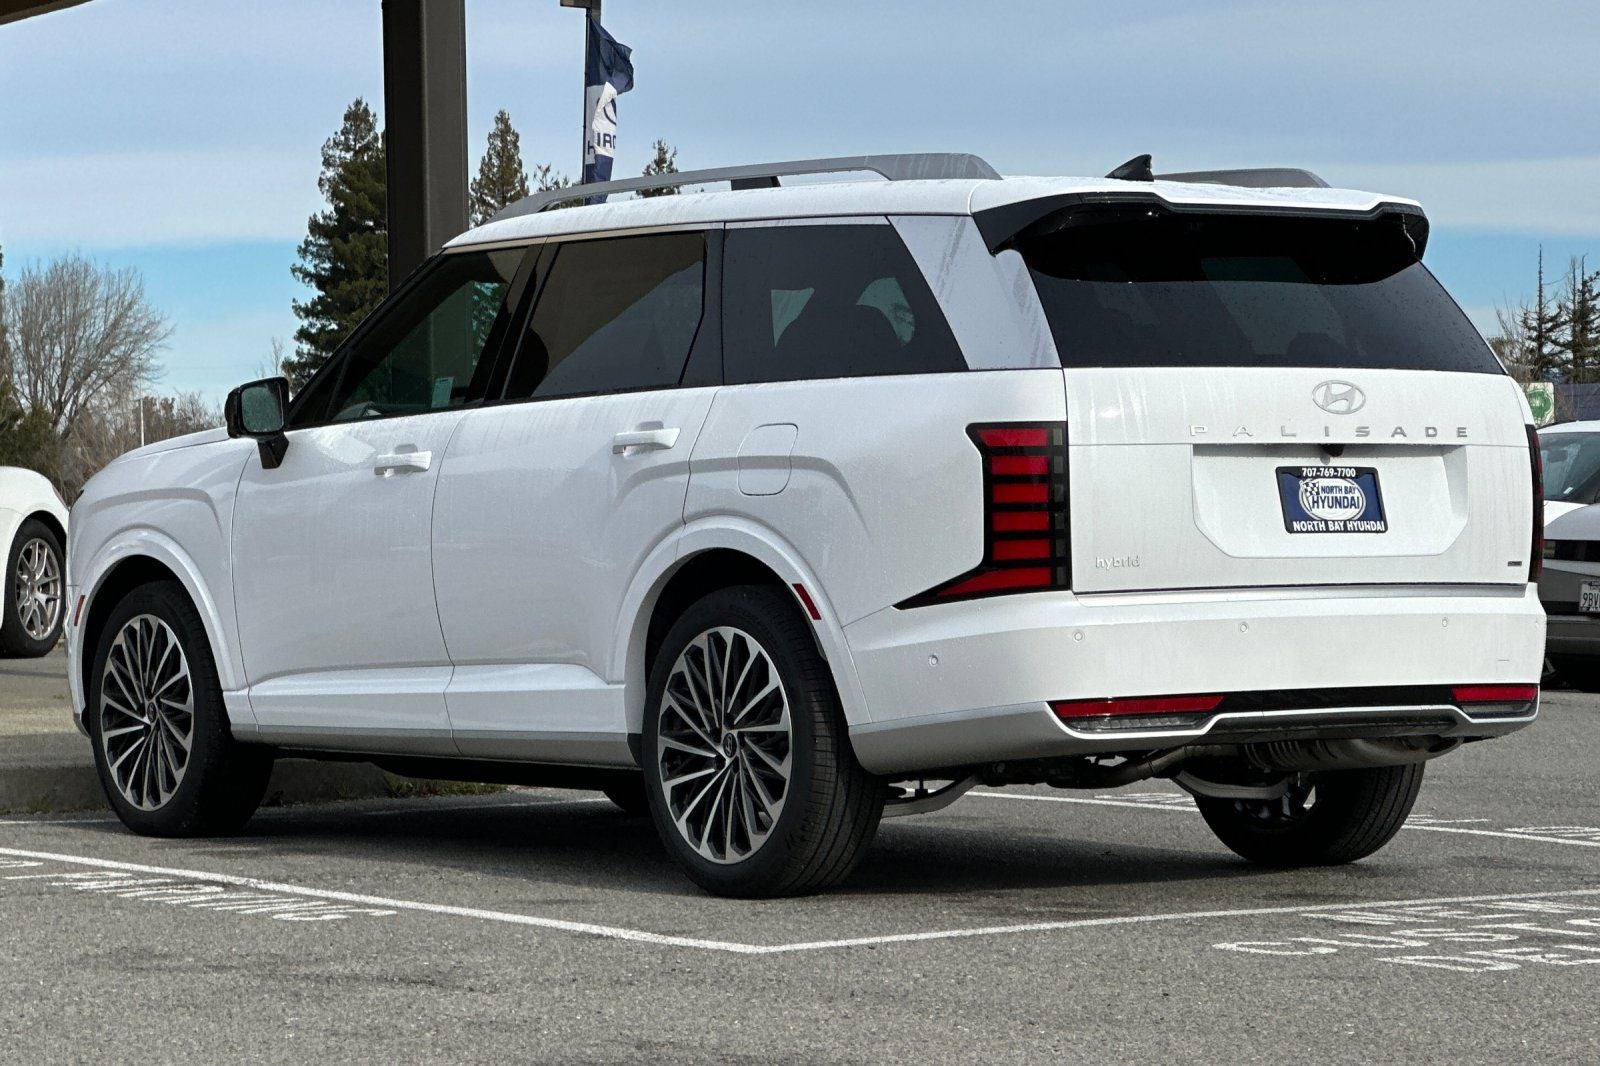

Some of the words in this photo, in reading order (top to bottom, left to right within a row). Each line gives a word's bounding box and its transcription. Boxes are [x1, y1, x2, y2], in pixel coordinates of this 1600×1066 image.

[1190, 424, 1468, 438] PALISADE
[1302, 467, 1356, 477] 707-769-7700
[1321, 485, 1342, 494] NORTH
[1344, 485, 1356, 494] BAY
[1312, 496, 1360, 509] HYUNDAI
[1293, 521, 1326, 532] NORTH
[1328, 521, 1344, 532] BAY
[1346, 521, 1385, 532] HYUNDAI
